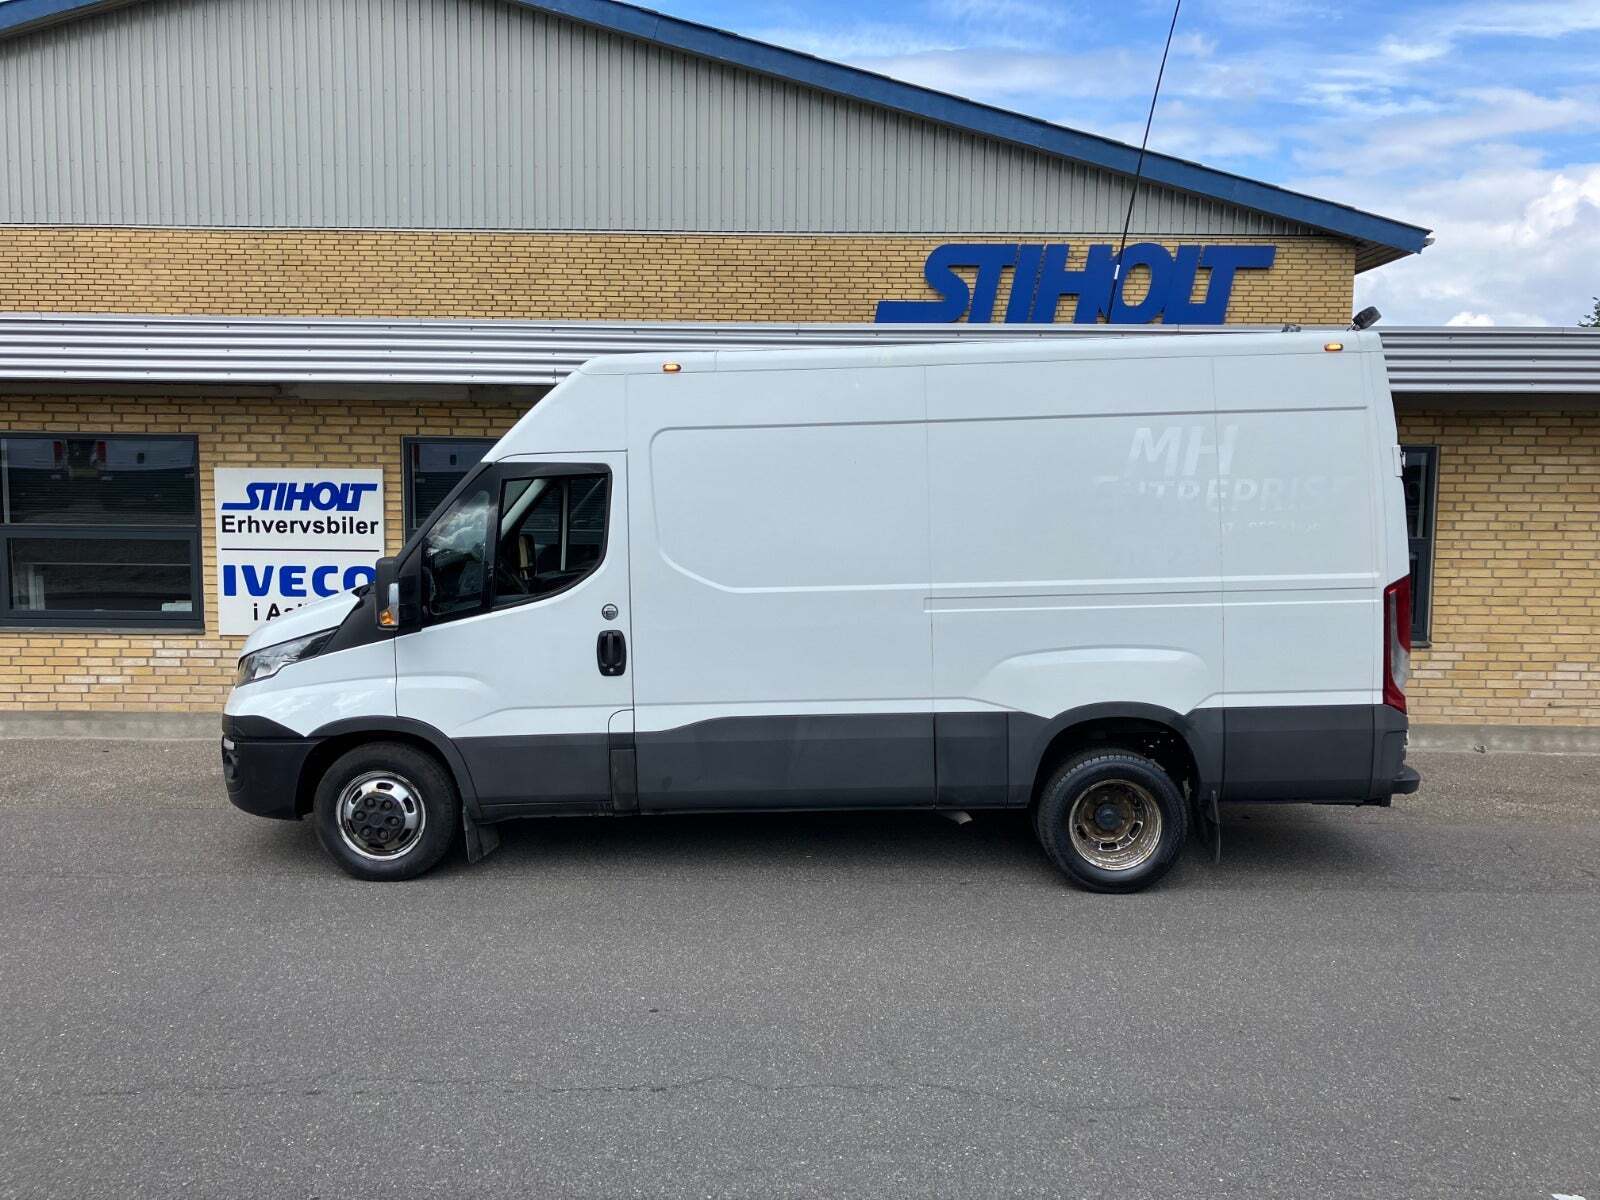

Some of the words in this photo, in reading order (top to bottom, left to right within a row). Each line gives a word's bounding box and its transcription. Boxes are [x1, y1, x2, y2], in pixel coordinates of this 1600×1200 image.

[875, 243, 1276, 324] STIHOLT
[1123, 424, 1240, 477] MH
[221, 481, 378, 511] STIHOLT
[221, 515, 379, 534] Erhvervsbiler
